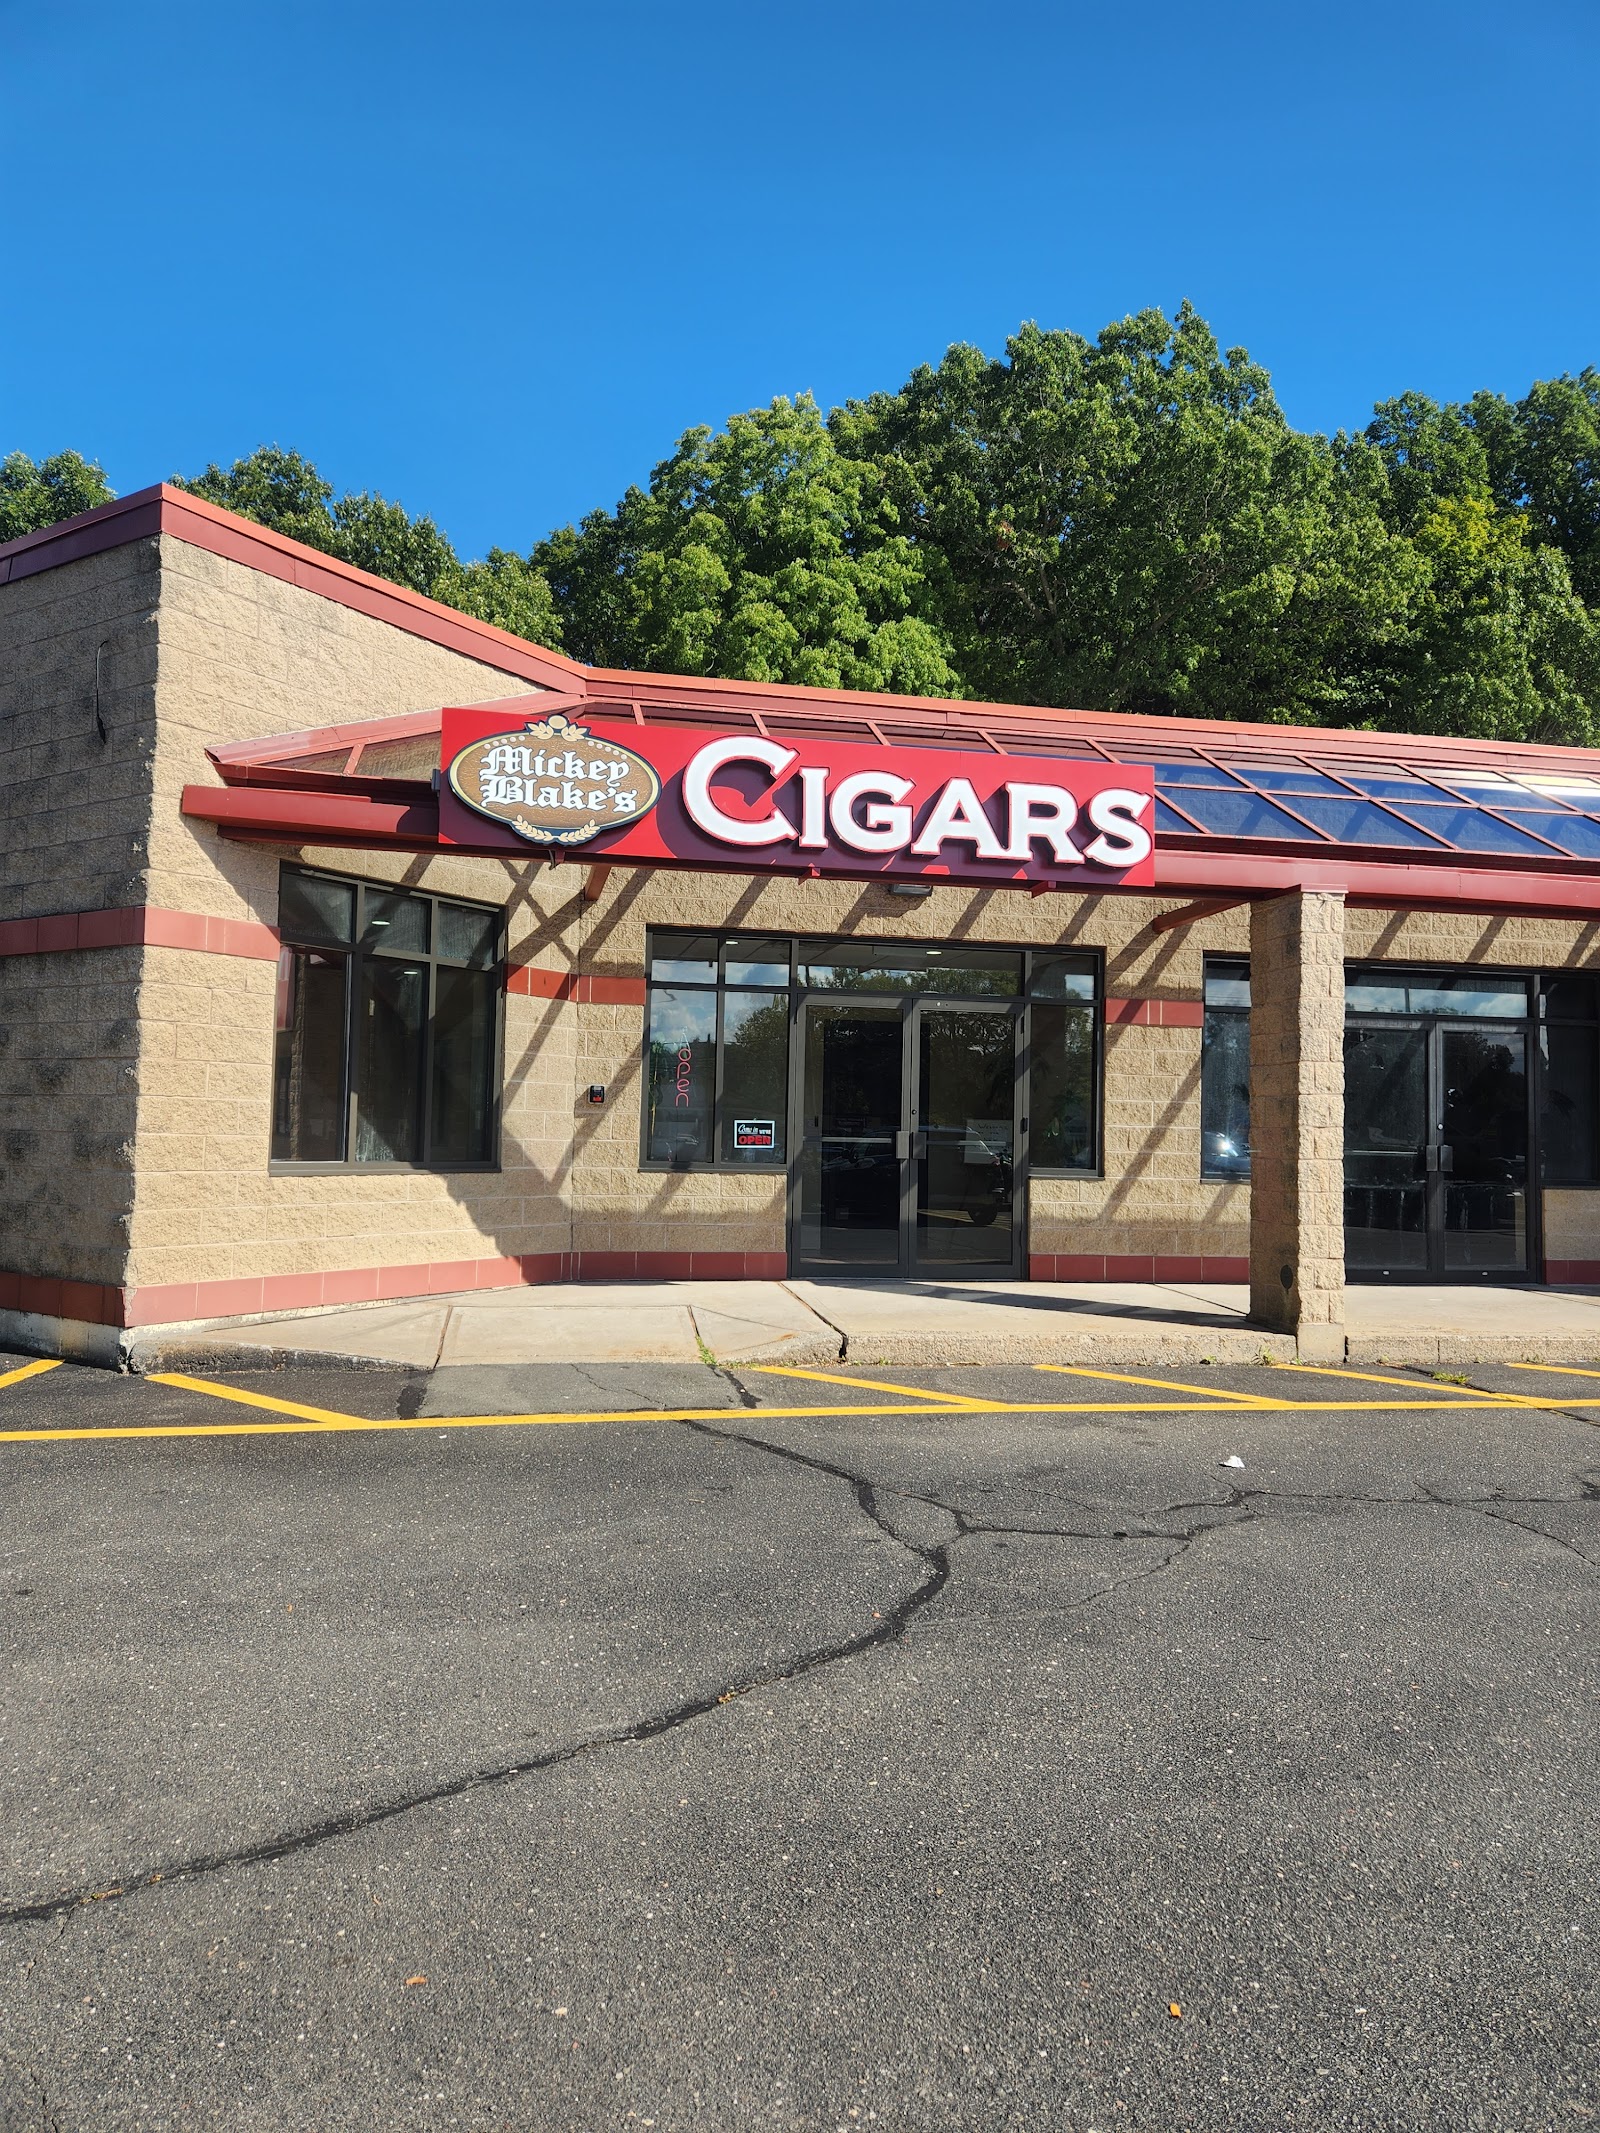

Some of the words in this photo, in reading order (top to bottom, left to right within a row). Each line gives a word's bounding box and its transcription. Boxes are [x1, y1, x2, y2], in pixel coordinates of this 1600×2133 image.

[479, 744, 630, 788] Mickey
[479, 774, 639, 813] Blake's
[684, 735, 1153, 868] CIGARS
[738, 1135, 771, 1145] OPEN
